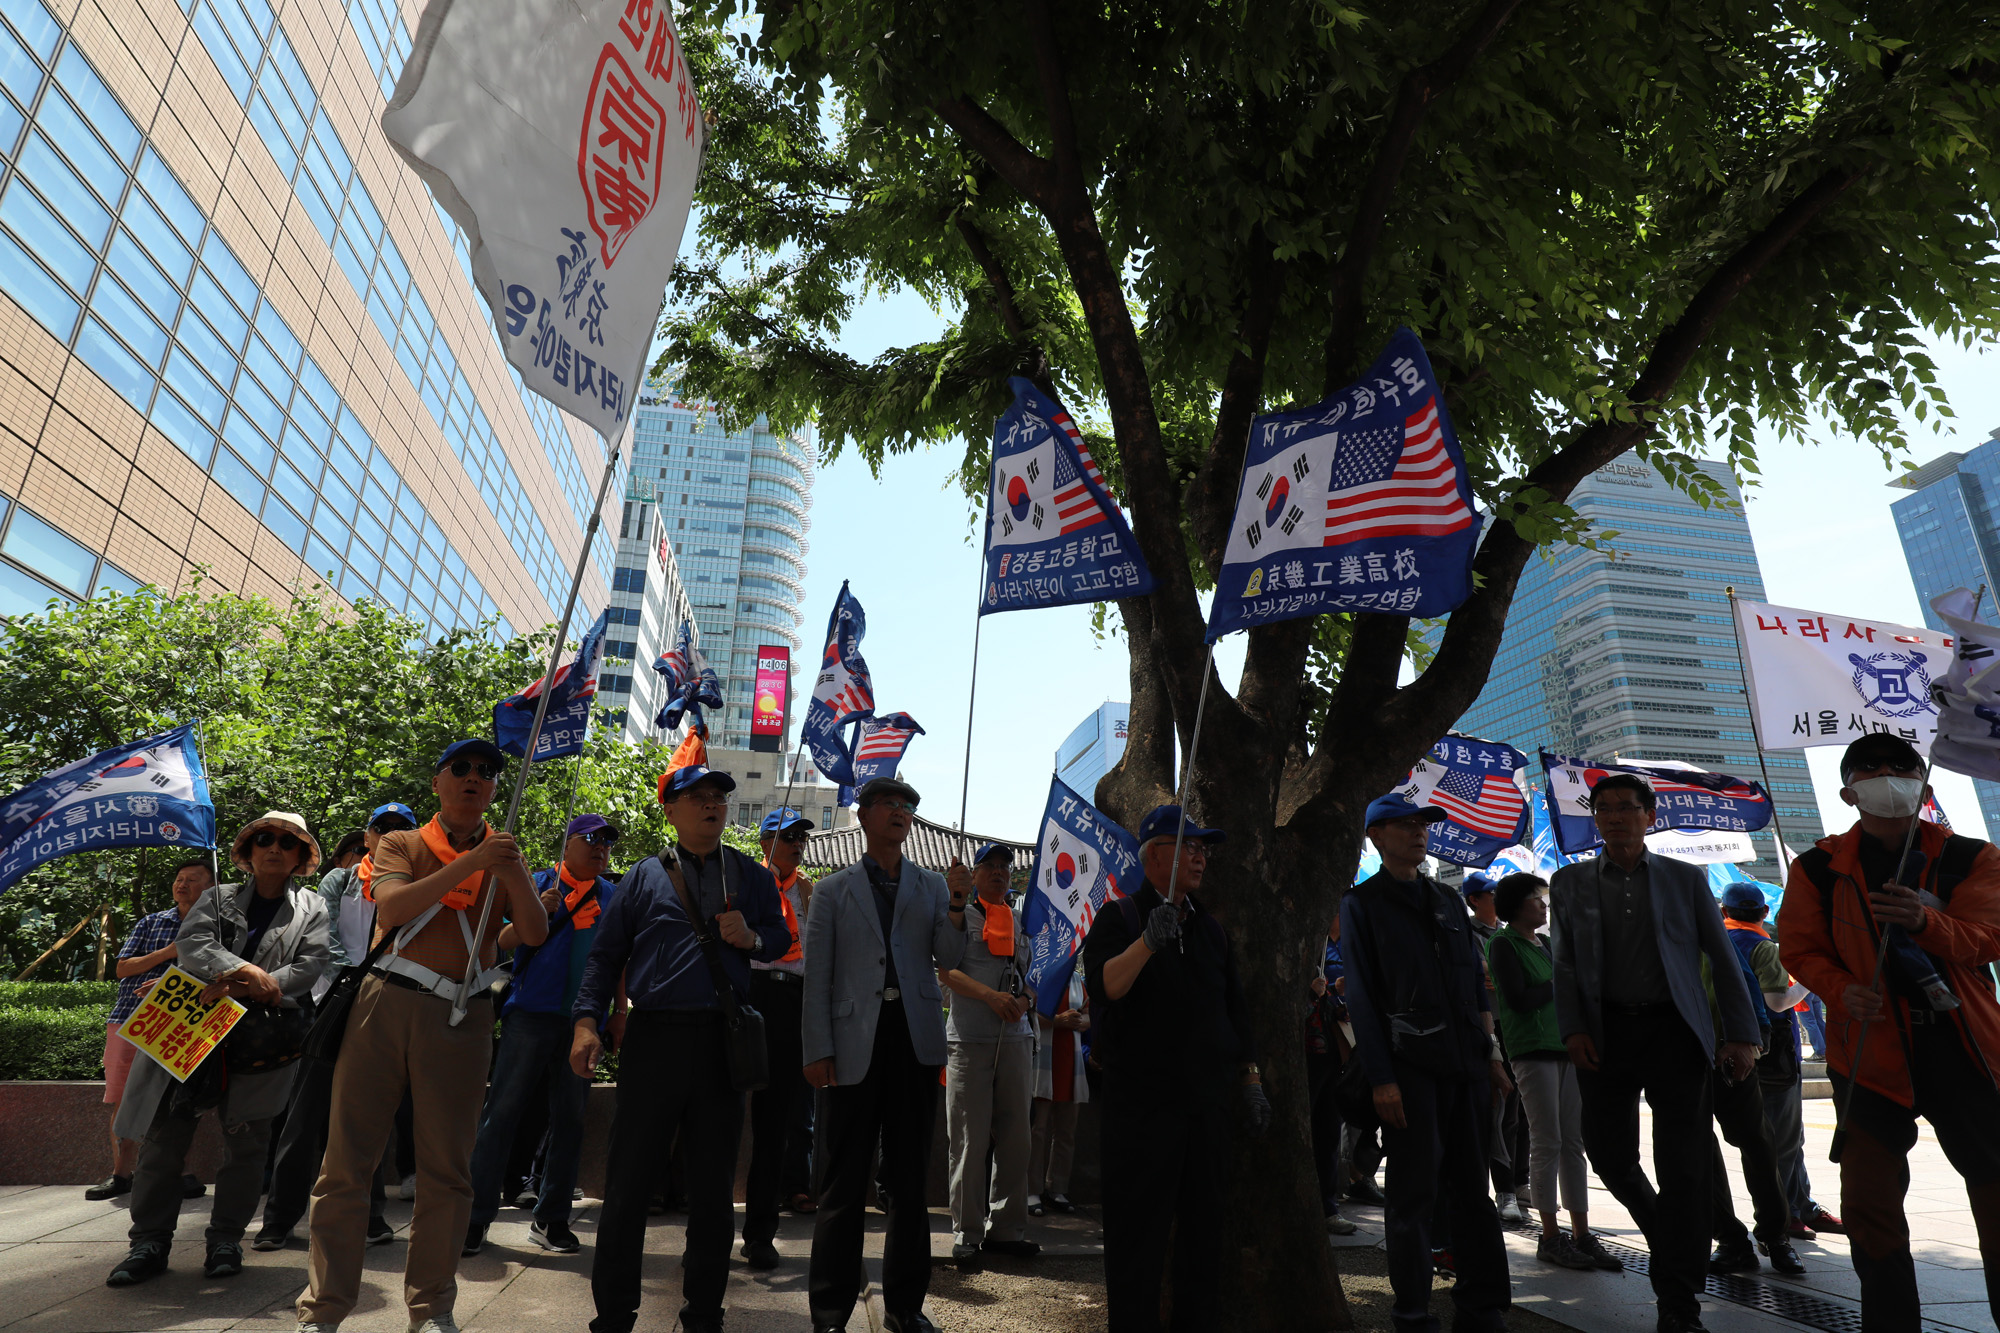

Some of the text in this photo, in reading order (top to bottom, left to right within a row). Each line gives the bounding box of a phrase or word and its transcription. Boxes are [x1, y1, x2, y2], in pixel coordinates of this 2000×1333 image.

[1011, 533, 1122, 574] 경동고등학교
[1266, 547, 1420, 591] 京畿工業高校
[998, 575, 1065, 602] 나라지킴이
[1071, 562, 1140, 592] 고교연합
[1327, 586, 1422, 611] 고교연합
[1679, 813, 1747, 831] 고교연합
[1697, 844, 1713, 852] 구국
[128, 1003, 213, 1075] 강제 북송 반대
